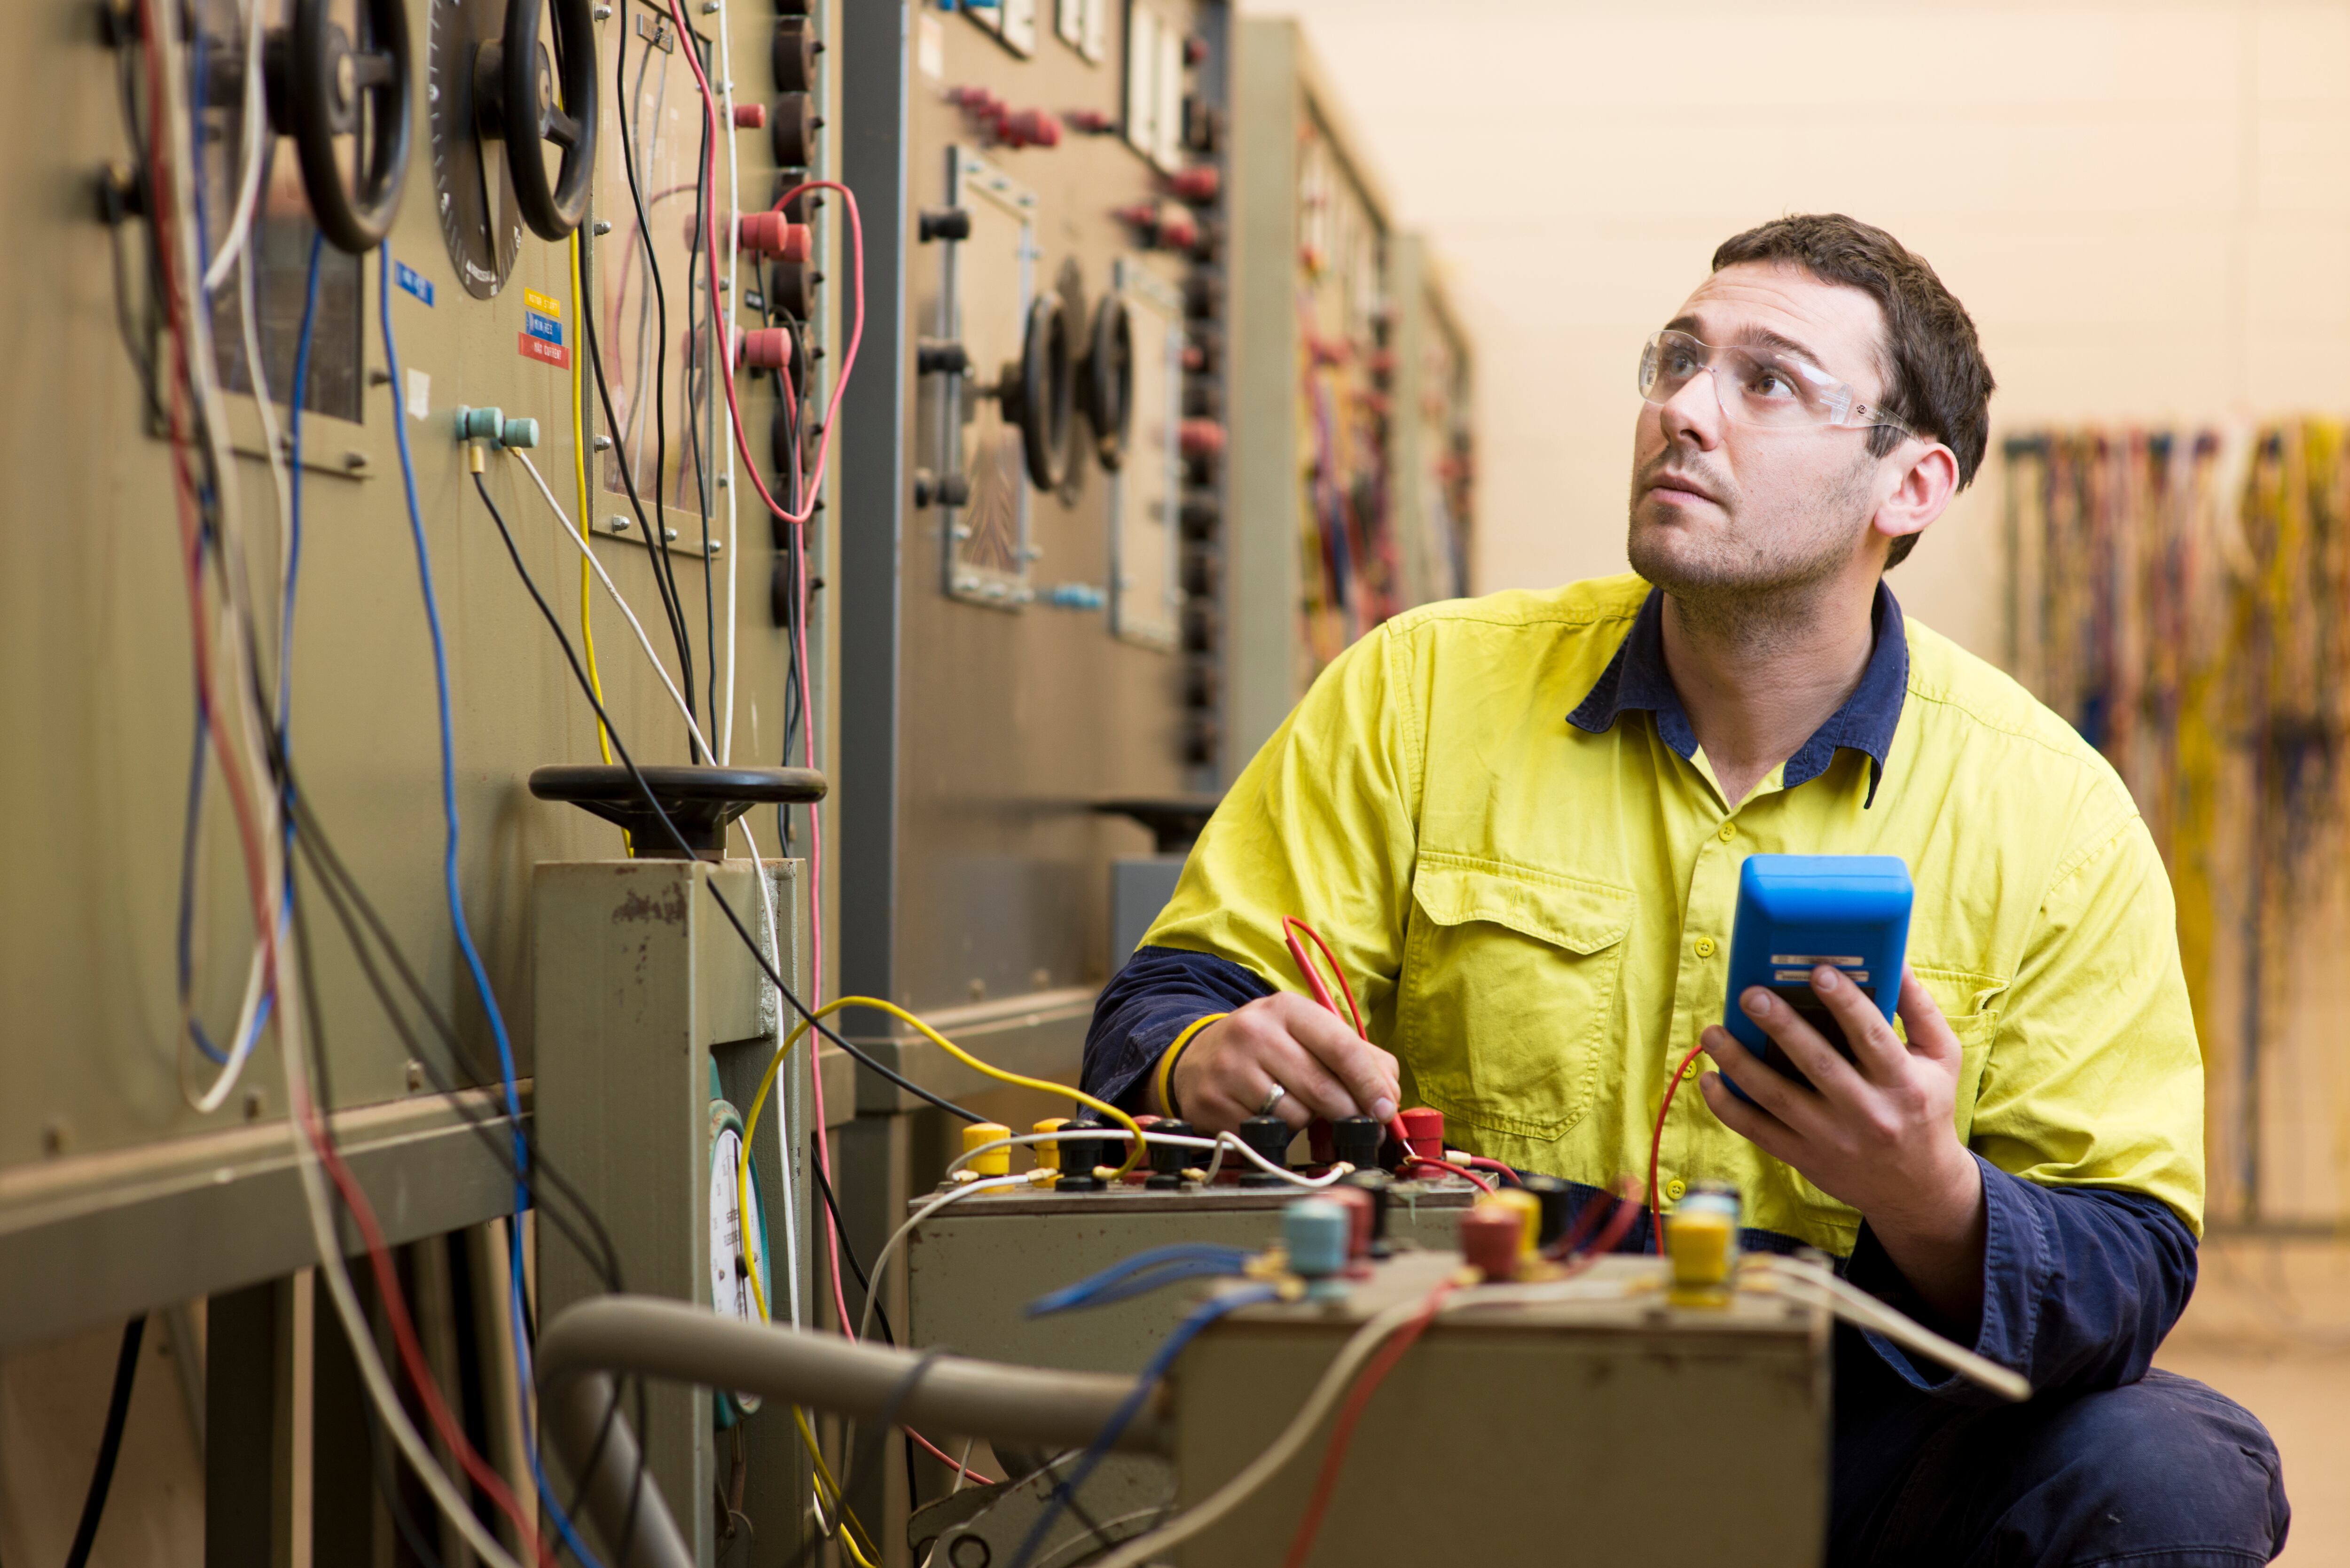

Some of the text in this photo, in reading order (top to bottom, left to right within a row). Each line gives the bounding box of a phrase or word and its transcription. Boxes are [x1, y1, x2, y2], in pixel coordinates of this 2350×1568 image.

[544, 300, 557, 312] START
[534, 319, 553, 335] MIN RES
[534, 342, 562, 360] MAX CURRENT
